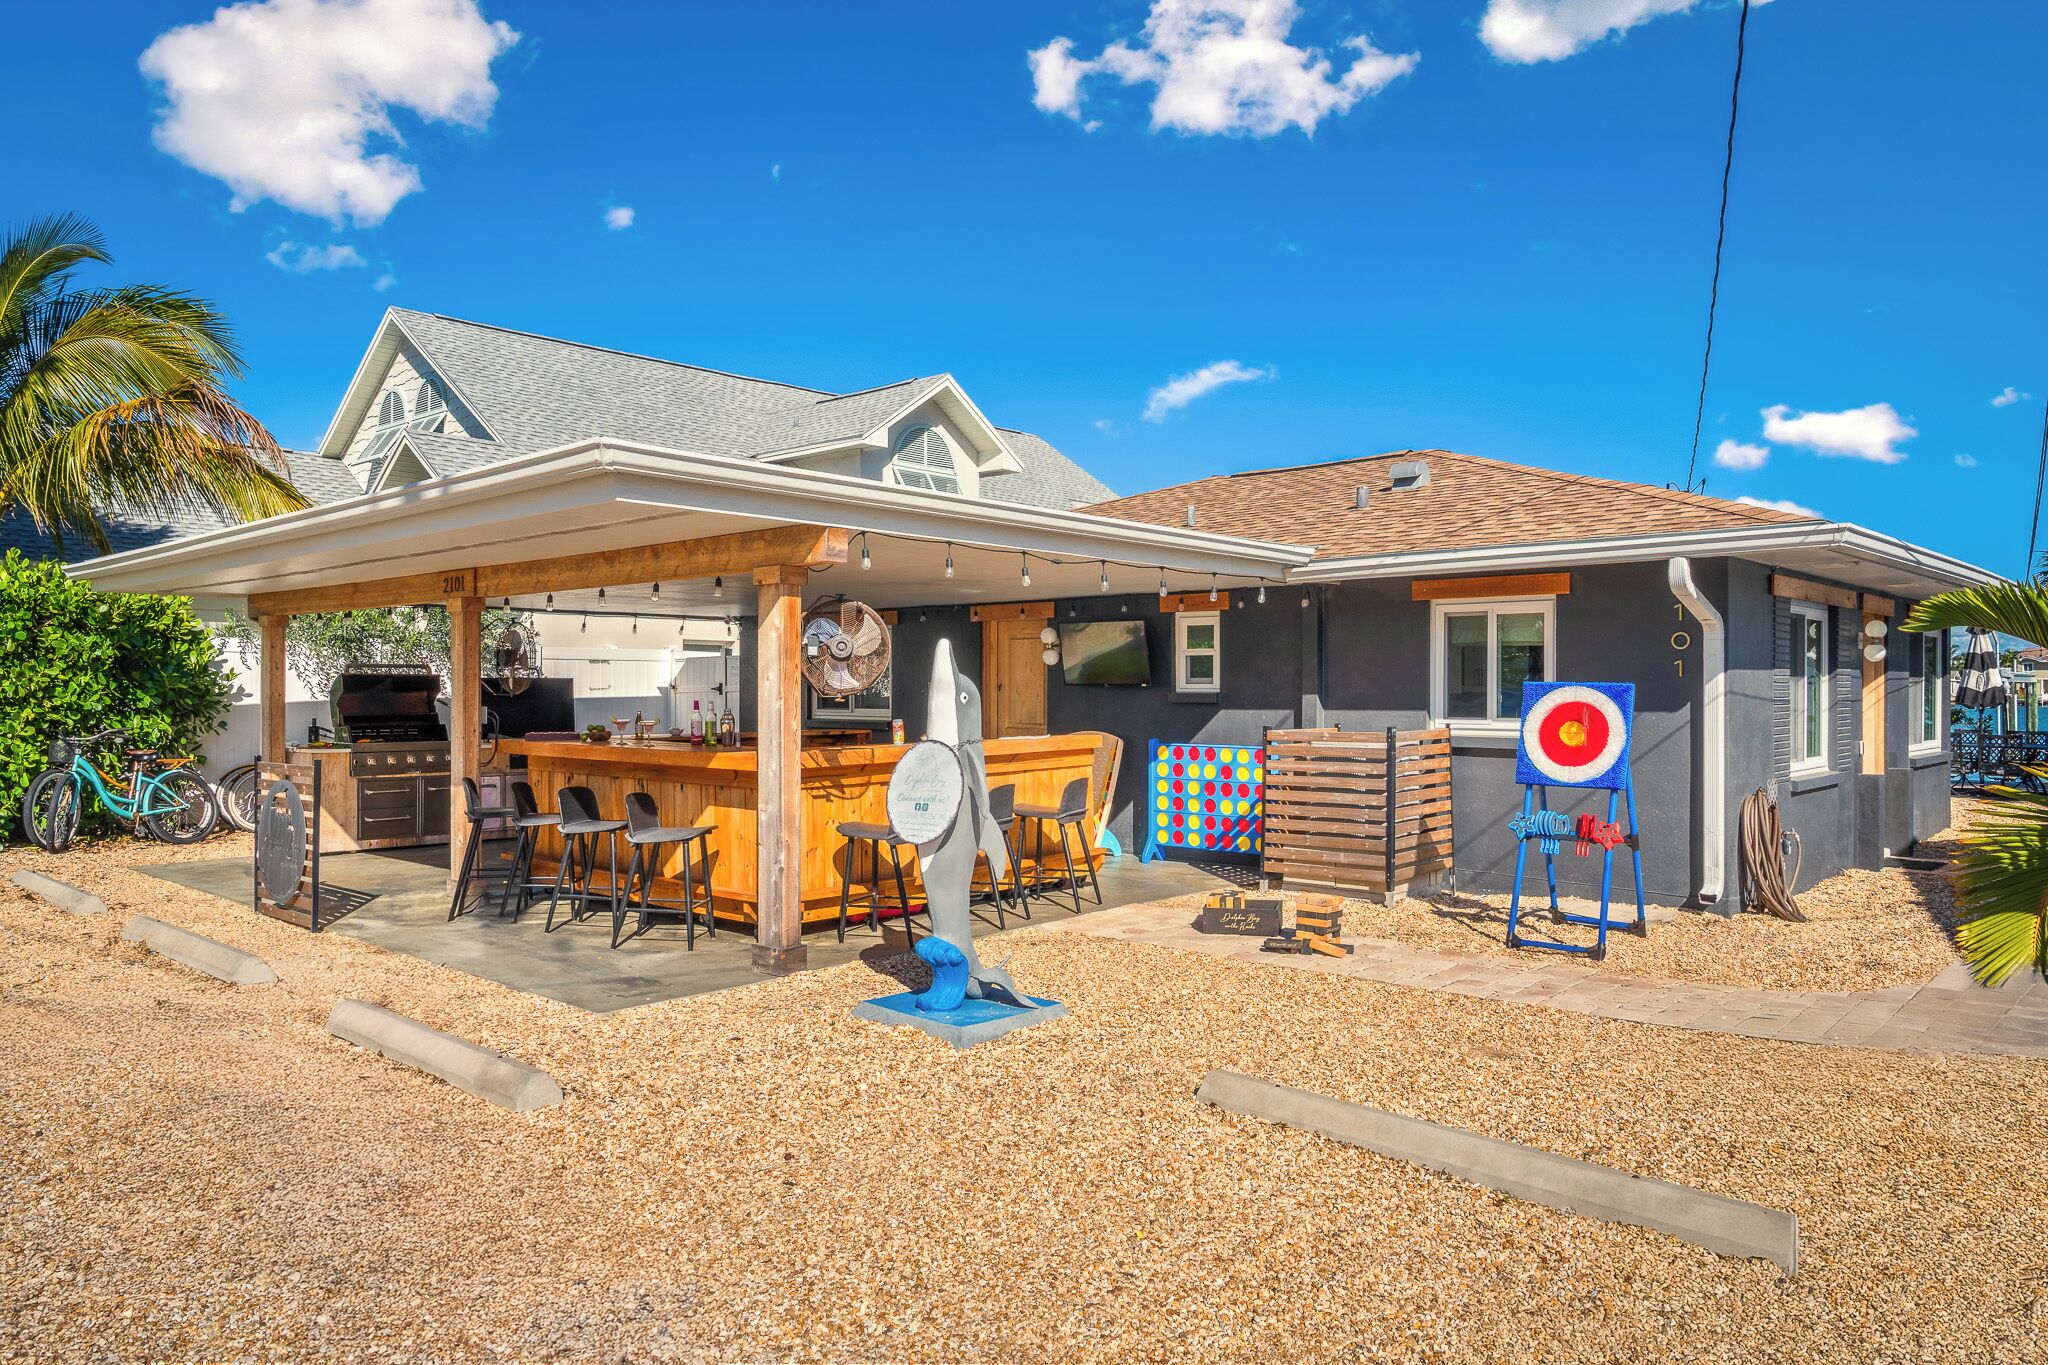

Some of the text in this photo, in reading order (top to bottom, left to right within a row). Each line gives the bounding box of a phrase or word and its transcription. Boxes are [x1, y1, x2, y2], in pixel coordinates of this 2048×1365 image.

[443, 576, 465, 593] 2101
[1220, 912, 1260, 923] Dolphin Bay
